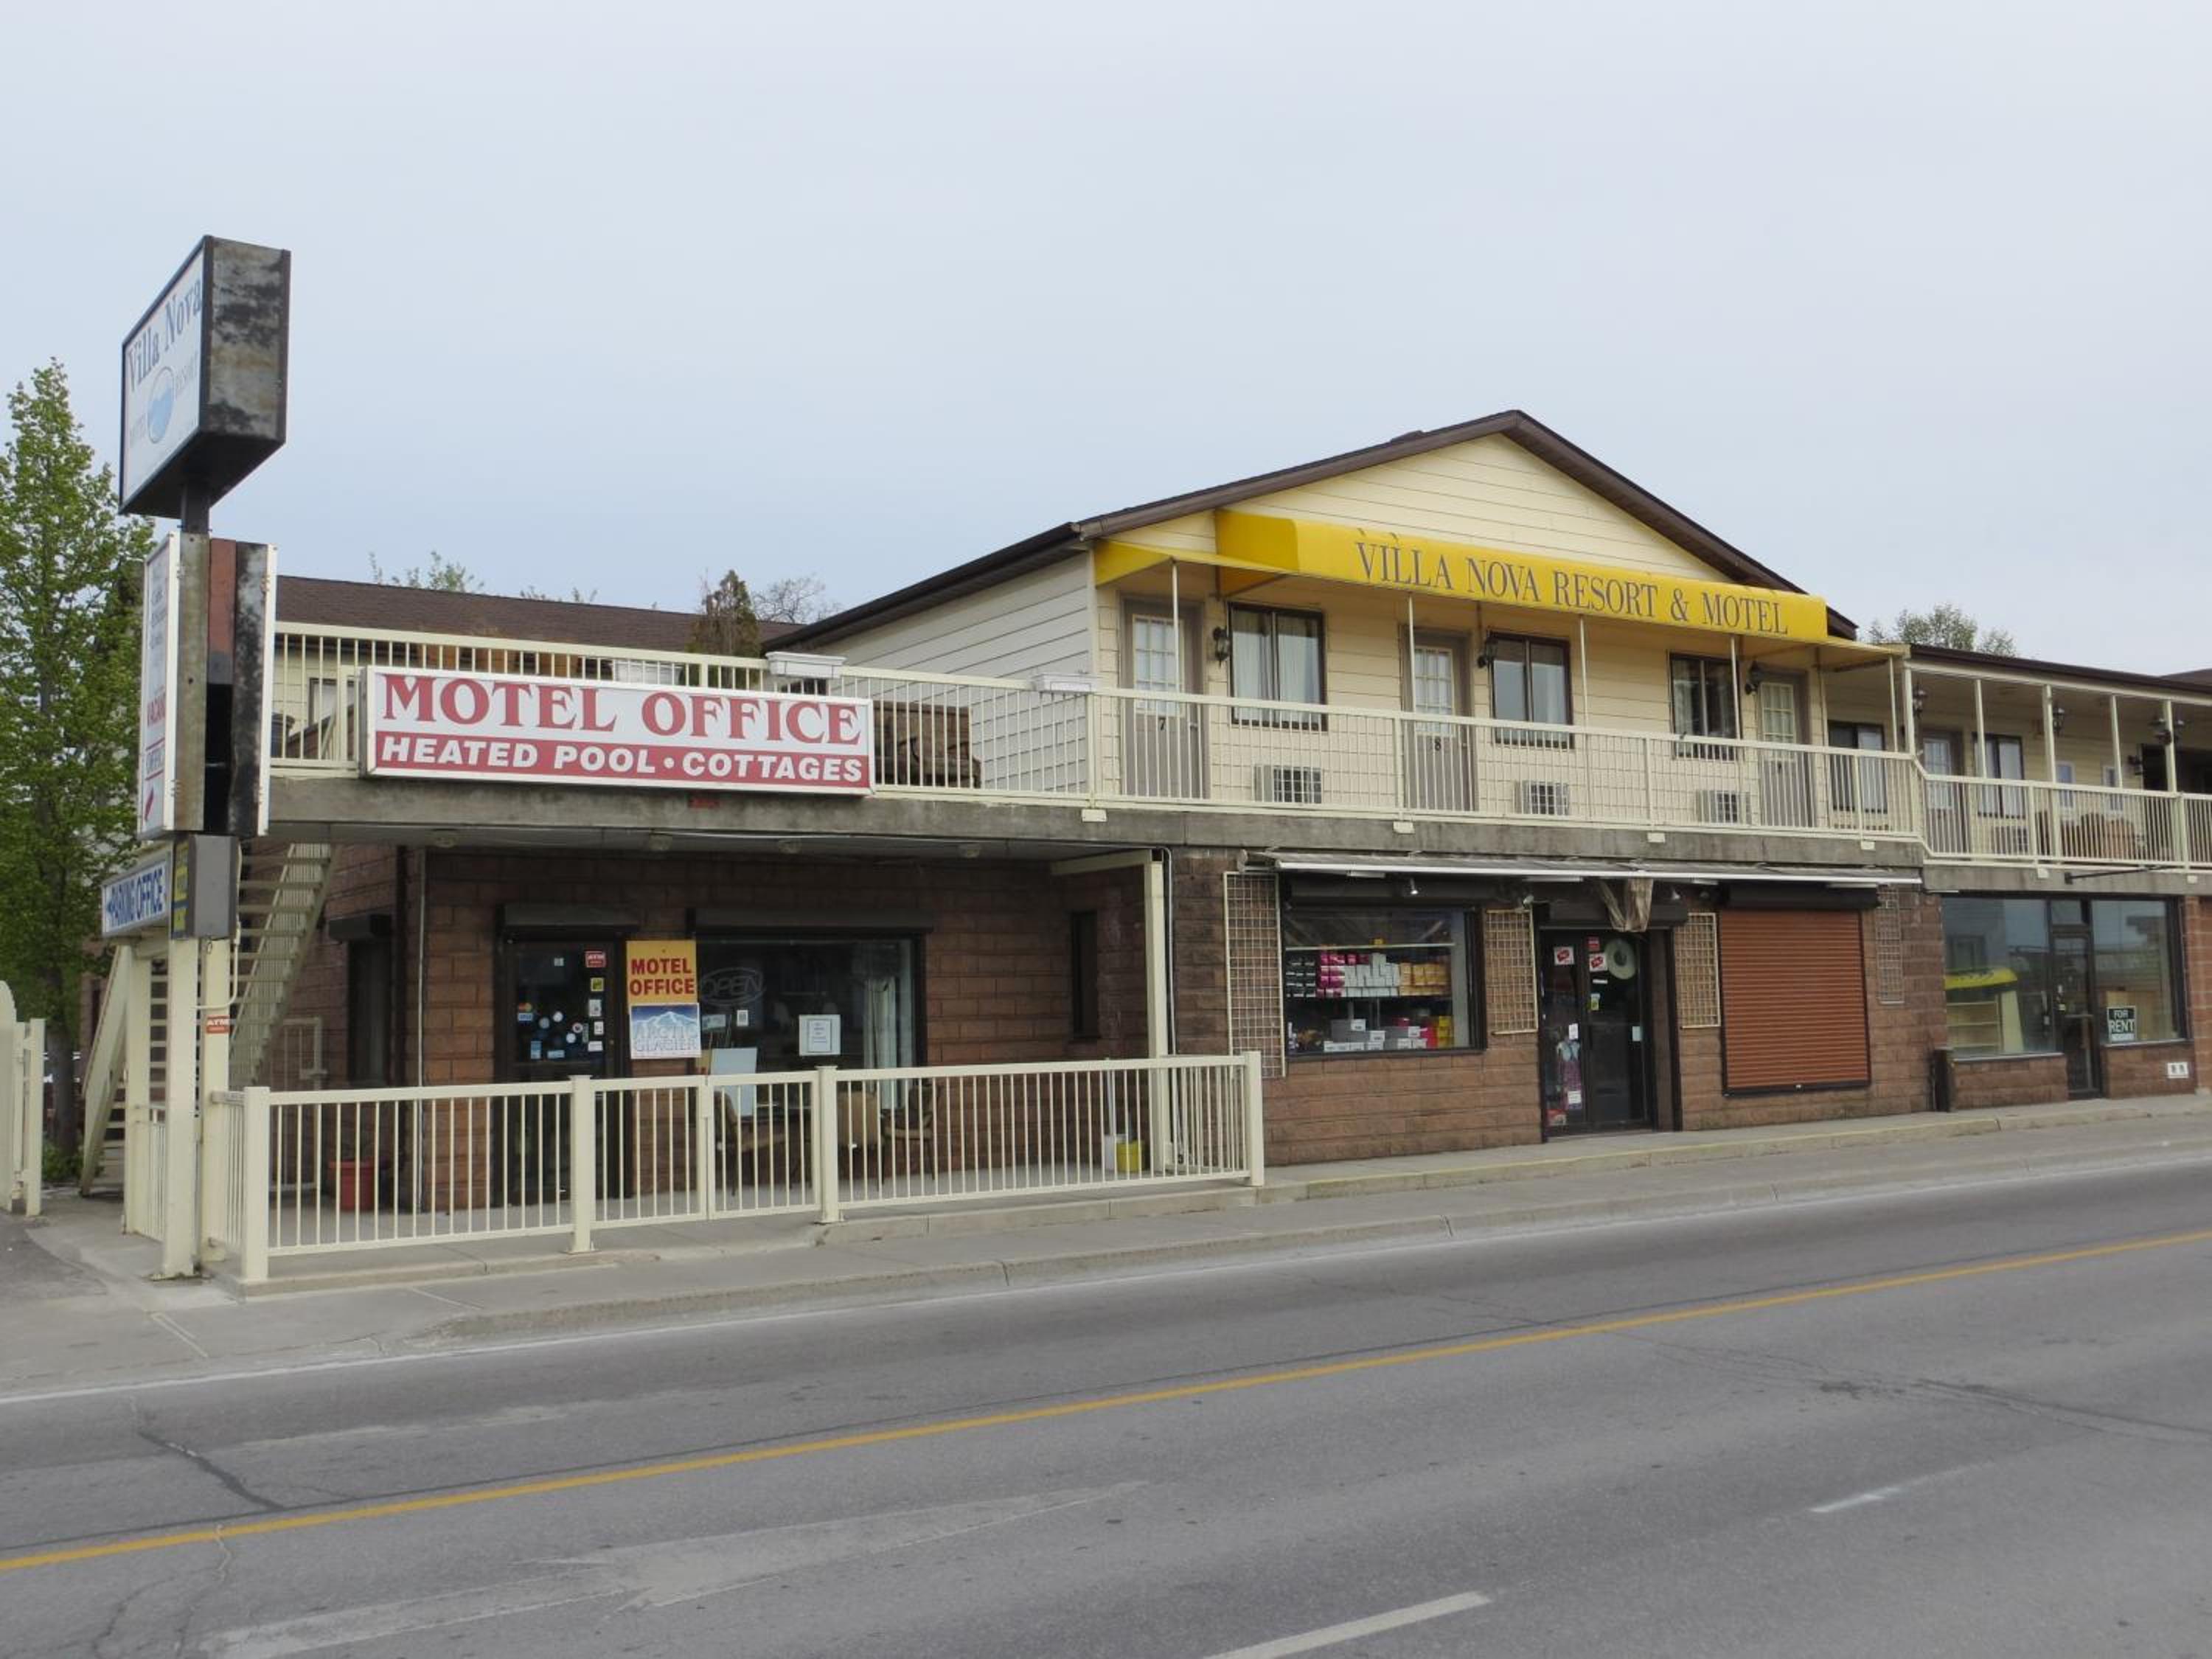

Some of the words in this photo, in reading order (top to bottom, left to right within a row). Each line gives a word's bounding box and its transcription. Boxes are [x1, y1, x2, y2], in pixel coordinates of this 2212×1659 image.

[128, 327, 159, 392] Villa
[164, 279, 202, 352] Nova
[1356, 542, 1452, 590] VILLA
[1466, 557, 1540, 603] NOVA
[1554, 570, 1658, 617] RESORT
[1670, 588, 1690, 621] &
[1703, 594, 1788, 636] MOTEL
[382, 673, 618, 732] MOTEL
[641, 691, 862, 745] OFFICE
[381, 736, 538, 768] HEATED
[554, 745, 656, 775] POOL
[682, 753, 863, 782] COTTAGES
[136, 866, 163, 921] OFFICE
[631, 958, 692, 975] MOTEL
[630, 978, 695, 996] OFFICE
[703, 974, 762, 998] OPEN
[2109, 1019, 2135, 1033] RENT
[2114, 1009, 2129, 1019] FOR
[634, 1038, 698, 1052] GLACIER
